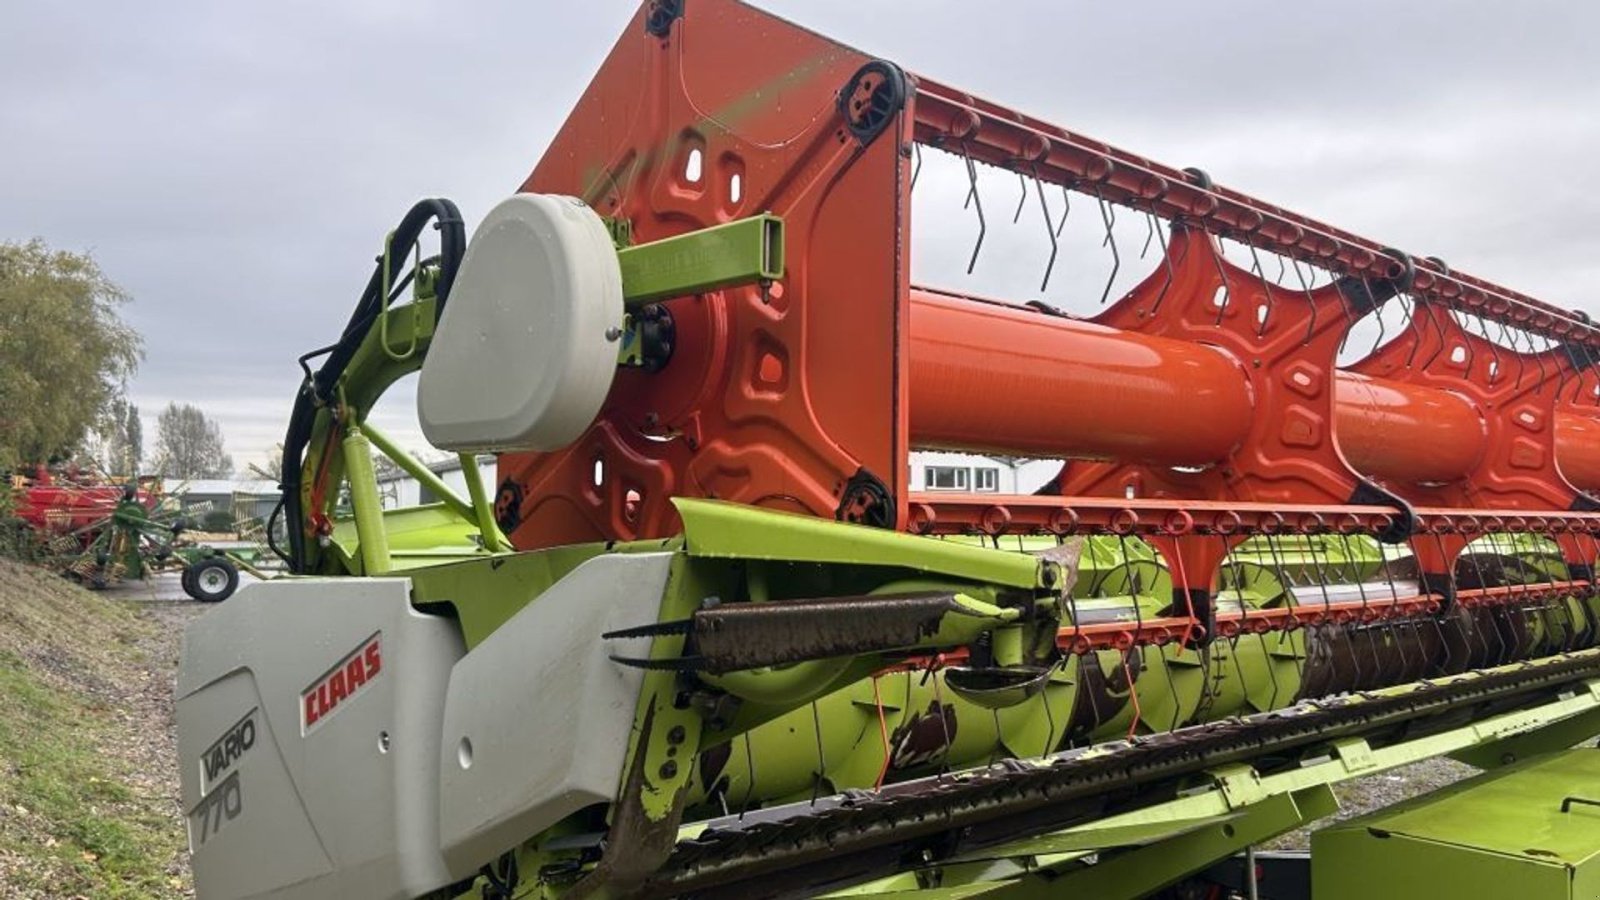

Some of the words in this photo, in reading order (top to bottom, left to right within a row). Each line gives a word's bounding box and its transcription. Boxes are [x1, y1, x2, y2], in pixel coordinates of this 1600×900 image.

[305, 641, 381, 727] CLAAS
[204, 718, 256, 782] VARIO
[197, 776, 241, 844] 770
